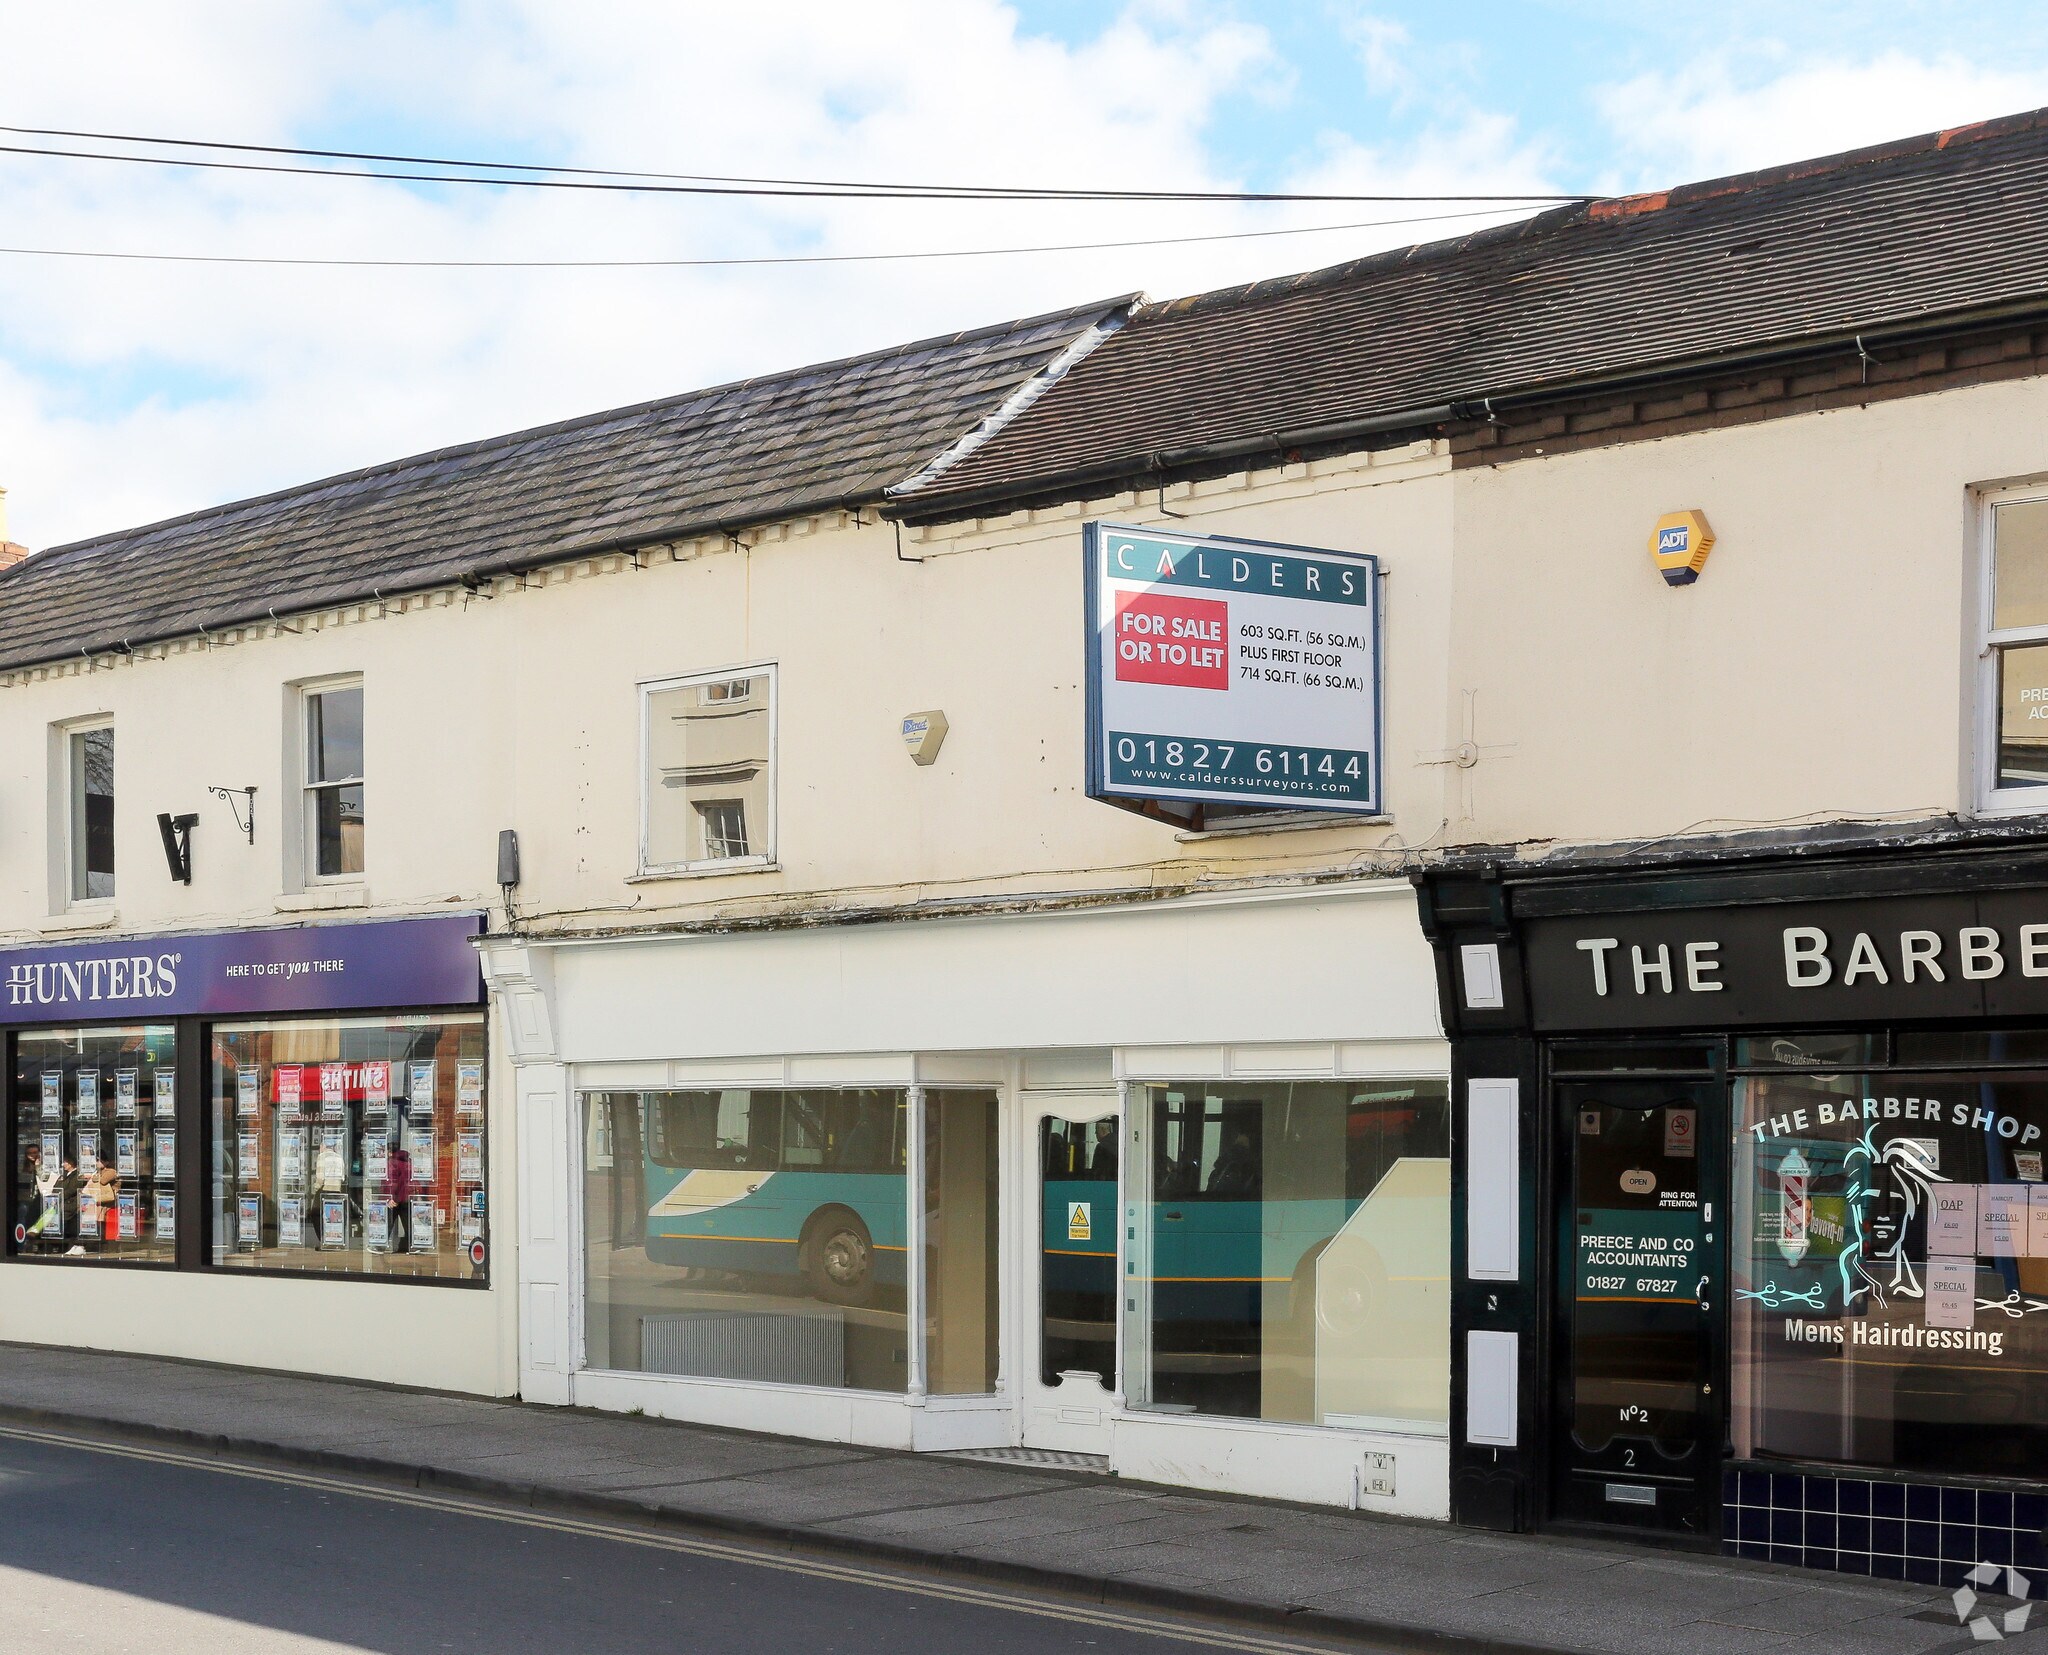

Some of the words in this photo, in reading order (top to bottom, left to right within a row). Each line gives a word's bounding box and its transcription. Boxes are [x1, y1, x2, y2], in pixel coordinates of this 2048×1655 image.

[1660, 531, 1687, 549] ADT
[1117, 543, 1354, 596] CALDERS
[1122, 612, 1165, 636] FOR
[1171, 617, 1221, 642] SALE
[1240, 624, 1263, 639] 603
[1267, 627, 1302, 643] SQ.FT.
[1306, 630, 1324, 646] (56
[1328, 633, 1366, 651] SQ.M.)
[1120, 640, 1152, 664] OR
[1157, 643, 1187, 666] TO
[1190, 646, 1224, 669] LET
[1240, 645, 1268, 660] PLUS
[1272, 648, 1299, 664] FIRST
[1304, 652, 1342, 668] FLOOR
[1240, 666, 1260, 680] 714
[1264, 669, 1299, 685] SQ.FT.
[1303, 672, 1321, 688] (66
[1325, 675, 1364, 692] SQ.M.)
[1118, 737, 1234, 770] 01827
[1255, 749, 1361, 780] 61144
[1131, 769, 1350, 793] www.calderssurveyors.com
[226, 964, 250, 977] HERE
[252, 963, 265, 976] TO
[267, 962, 285, 975] GET
[286, 961, 310, 980] you
[313, 959, 344, 973] THERE
[1576, 937, 1723, 996] THE
[1783, 924, 2048, 987] BARBE
[1750, 1109, 1809, 1144] THE
[1818, 1097, 1941, 1125] BARBER
[1951, 1104, 2041, 1145] SHOP
[1629, 1177, 1648, 1186] OPEN
[1659, 1199, 1698, 1208] ATTENTION
[1661, 1191, 1678, 1199] RING
[1680, 1191, 1696, 1200] FOR
[1941, 1199, 1964, 1210] OAP
[1984, 1213, 2020, 1222] SPECIAL
[1580, 1235, 1633, 1250] PREECE
[1638, 1237, 1667, 1251] AND
[1673, 1238, 1694, 1252] CO
[1587, 1251, 1688, 1268] ACCOUNTANTS
[1586, 1275, 1626, 1290] 01827
[1636, 1278, 1678, 1293] 67827
[1933, 1281, 1967, 1291] SPECIAL
[1853, 1321, 2003, 1356] Hairdressing
[1625, 1448, 1635, 1467] 2
